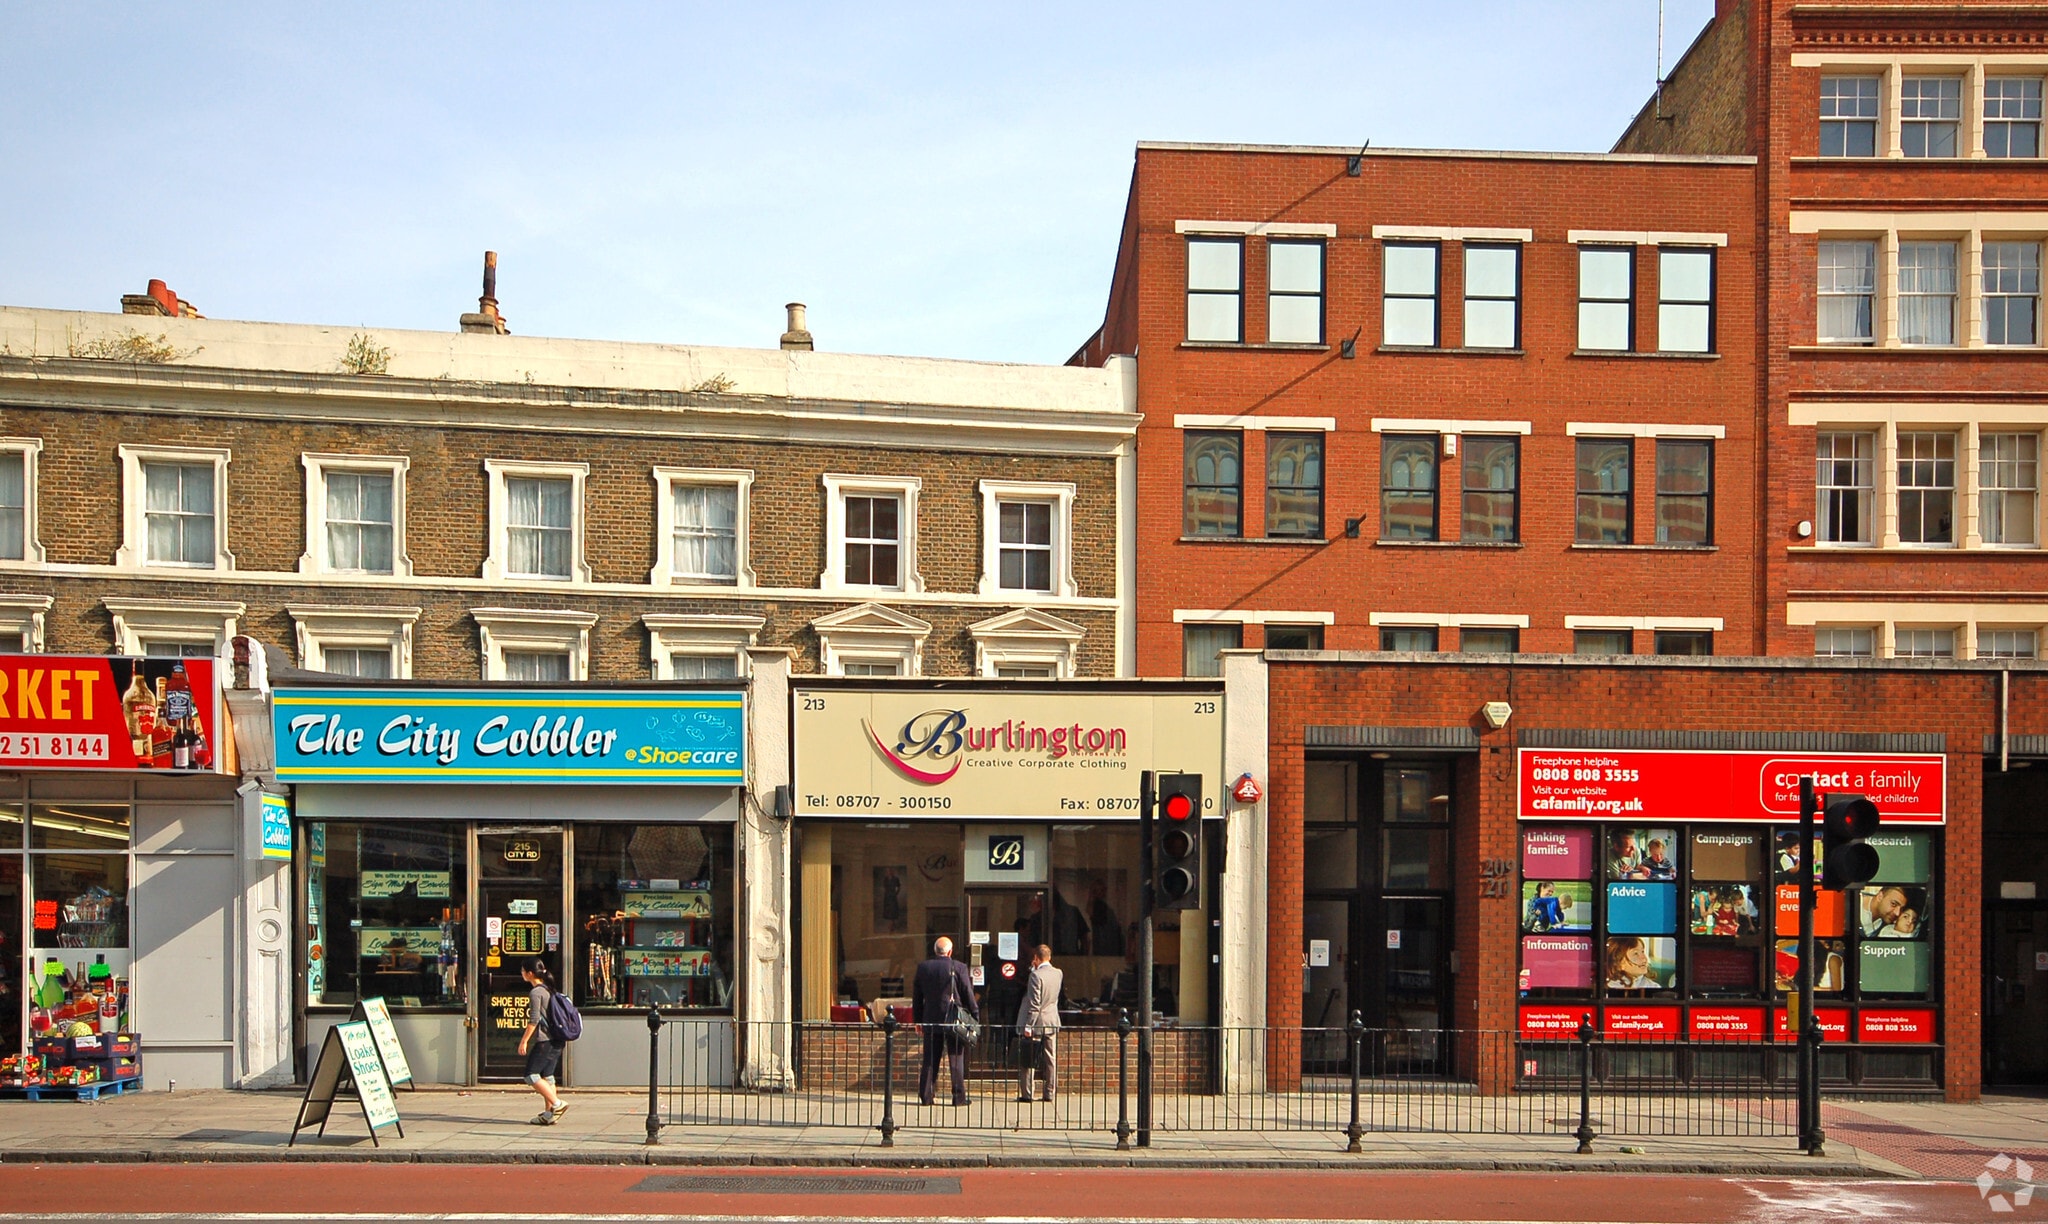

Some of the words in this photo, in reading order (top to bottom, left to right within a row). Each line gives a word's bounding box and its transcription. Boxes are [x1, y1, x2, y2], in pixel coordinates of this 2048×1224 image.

[804, 698, 826, 710] 213
[1194, 702, 1216, 714] 213
[897, 708, 1127, 757] Burlington
[290, 714, 364, 754] The
[378, 714, 460, 765] City
[475, 716, 617, 755] Cobbler
[51, 737, 103, 756] 8144
[966, 758, 1013, 768] Creative
[1019, 759, 1075, 769] Corporate
[1080, 759, 1127, 770] Clothing
[1533, 756, 1581, 767] Freephone
[1584, 757, 1619, 767] helpline
[1533, 768, 1569, 780] 0808
[1574, 769, 1600, 781] 808
[1605, 769, 1639, 782] 3555
[1854, 778, 1864, 787] a
[1870, 770, 1921, 792] family
[1532, 785, 1552, 794] Visit
[1553, 787, 1570, 795] our
[1572, 786, 1607, 795] website
[805, 796, 830, 808] Tel:
[836, 796, 880, 808] 08707
[899, 797, 951, 809] 300150
[1775, 792, 1787, 801] for
[1884, 795, 1919, 803] children
[1060, 798, 1089, 809] Fax:
[1097, 798, 1140, 810] 08707
[1532, 796, 1644, 814] cafamily.org.uk
[1527, 832, 1566, 845] Linking
[1696, 833, 1753, 846] Campaigns
[990, 840, 1021, 865] B
[1527, 845, 1569, 855] families
[1483, 857, 1516, 876] 209
[1611, 887, 1646, 896] Advice
[626, 901, 649, 910] Key
[652, 901, 692, 910] Cutting
[1527, 940, 1588, 950] Information
[1865, 946, 1905, 958] Support
[491, 997, 513, 1006] SHOE
[504, 1007, 525, 1017] KEYS
[496, 1018, 520, 1028] WHILE
[1612, 1021, 1664, 1030] cafamily.org.uk
[348, 1044, 375, 1060] Loake
[353, 1060, 380, 1076] Shoes
